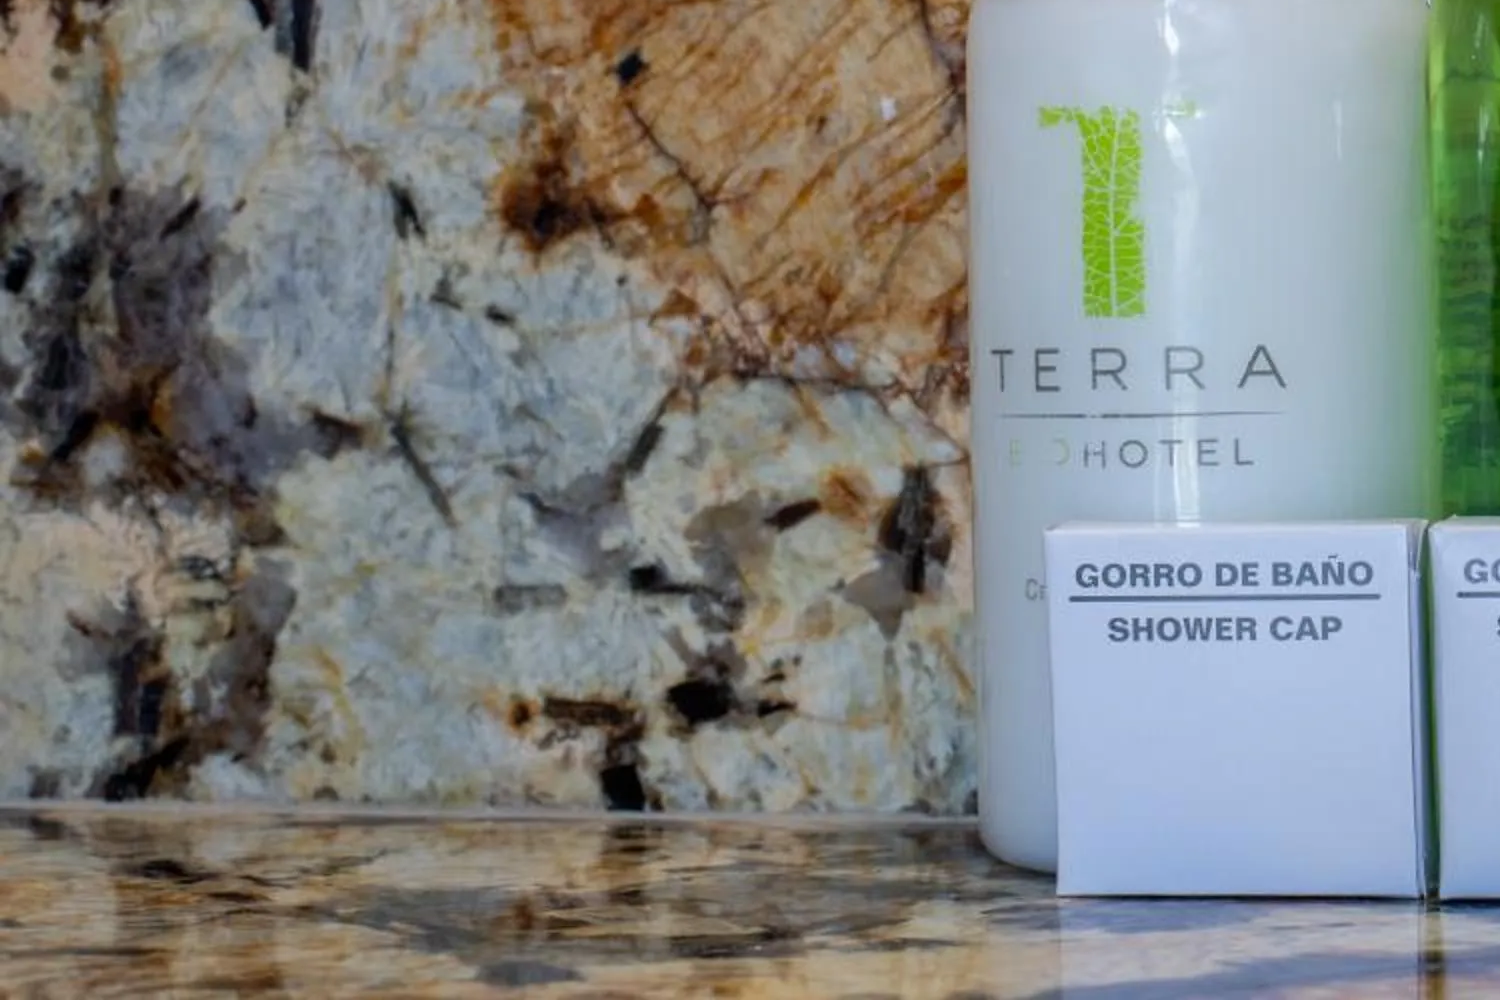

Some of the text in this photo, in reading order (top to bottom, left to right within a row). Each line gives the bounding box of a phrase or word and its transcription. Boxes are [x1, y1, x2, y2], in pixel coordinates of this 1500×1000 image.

[990, 344, 1288, 393] TERRA
[1074, 562, 1204, 589] GORRO
[1214, 561, 1260, 587] DE
[1271, 554, 1374, 587] BAÑO
[1106, 615, 1343, 642] SHOWER CAP
